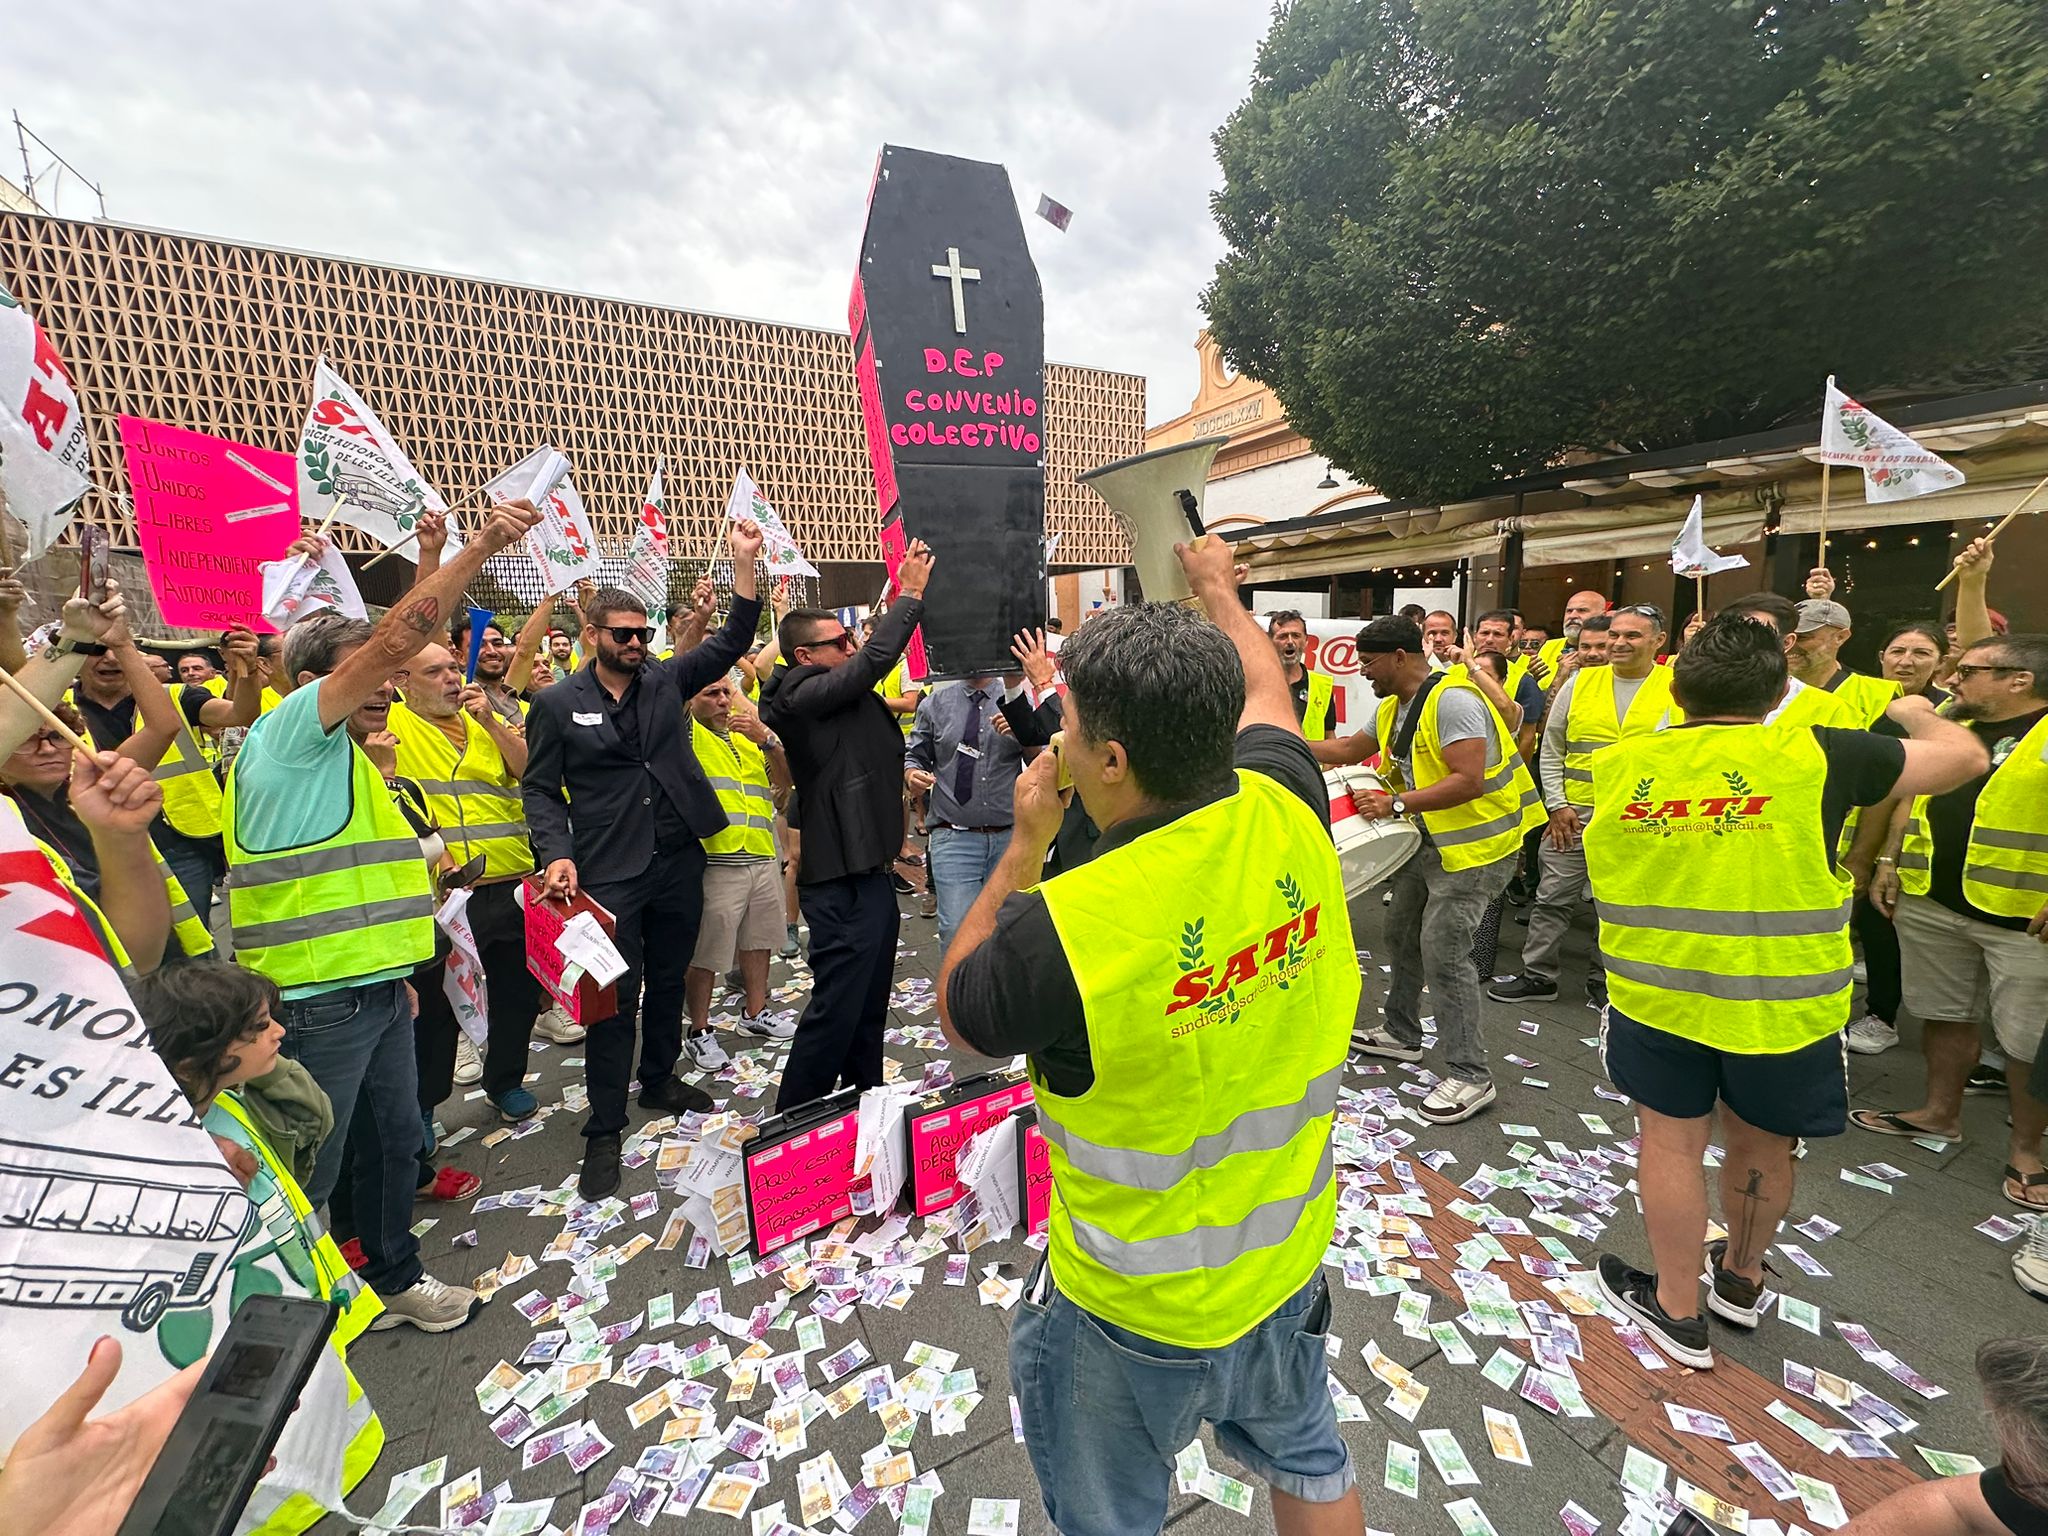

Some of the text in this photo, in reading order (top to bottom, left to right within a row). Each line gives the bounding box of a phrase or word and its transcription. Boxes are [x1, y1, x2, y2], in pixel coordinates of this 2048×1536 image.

[923, 347, 1004, 377] D.E.P
[136, 426, 211, 467] JUNTOS
[141, 460, 207, 500] UNIDOS
[149, 497, 213, 533] LIBRES
[158, 536, 265, 576] INDEPENDIENT
[163, 573, 254, 607] AUTONOMOS
[1619, 796, 1773, 820] SATI
[1165, 902, 1321, 1016] SATI
[930, 1122, 966, 1154] AQUÍ
[813, 1175, 832, 1188] DE
